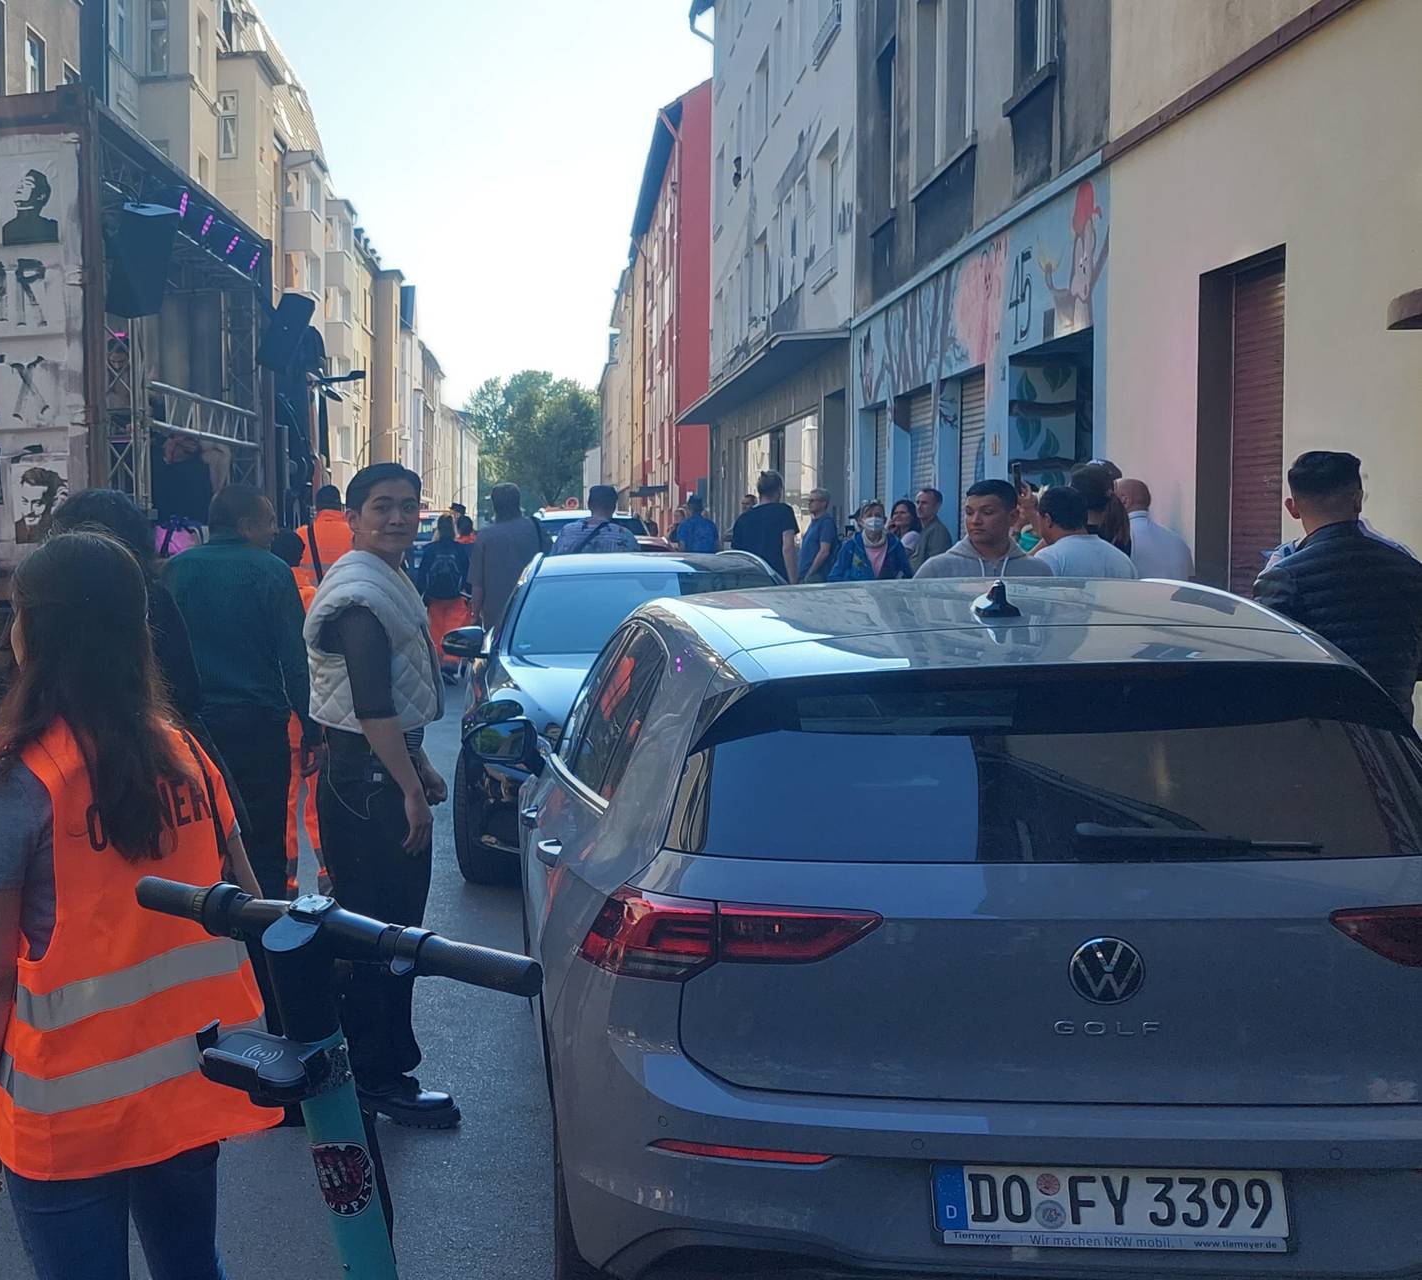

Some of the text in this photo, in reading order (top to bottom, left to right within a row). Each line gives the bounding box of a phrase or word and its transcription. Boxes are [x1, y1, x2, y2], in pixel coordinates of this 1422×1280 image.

[1009, 247, 1033, 345] 45
[85, 778, 212, 853] ONER
[1053, 1019, 1161, 1036] GOLF
[945, 1173, 1273, 1229] D DO FY 3399
[953, 1231, 1002, 1243] Tiemeyer
[1030, 1236, 1049, 1246] Wir
[1052, 1237, 1101, 1247] machen
[1104, 1238, 1133, 1247] NRW
